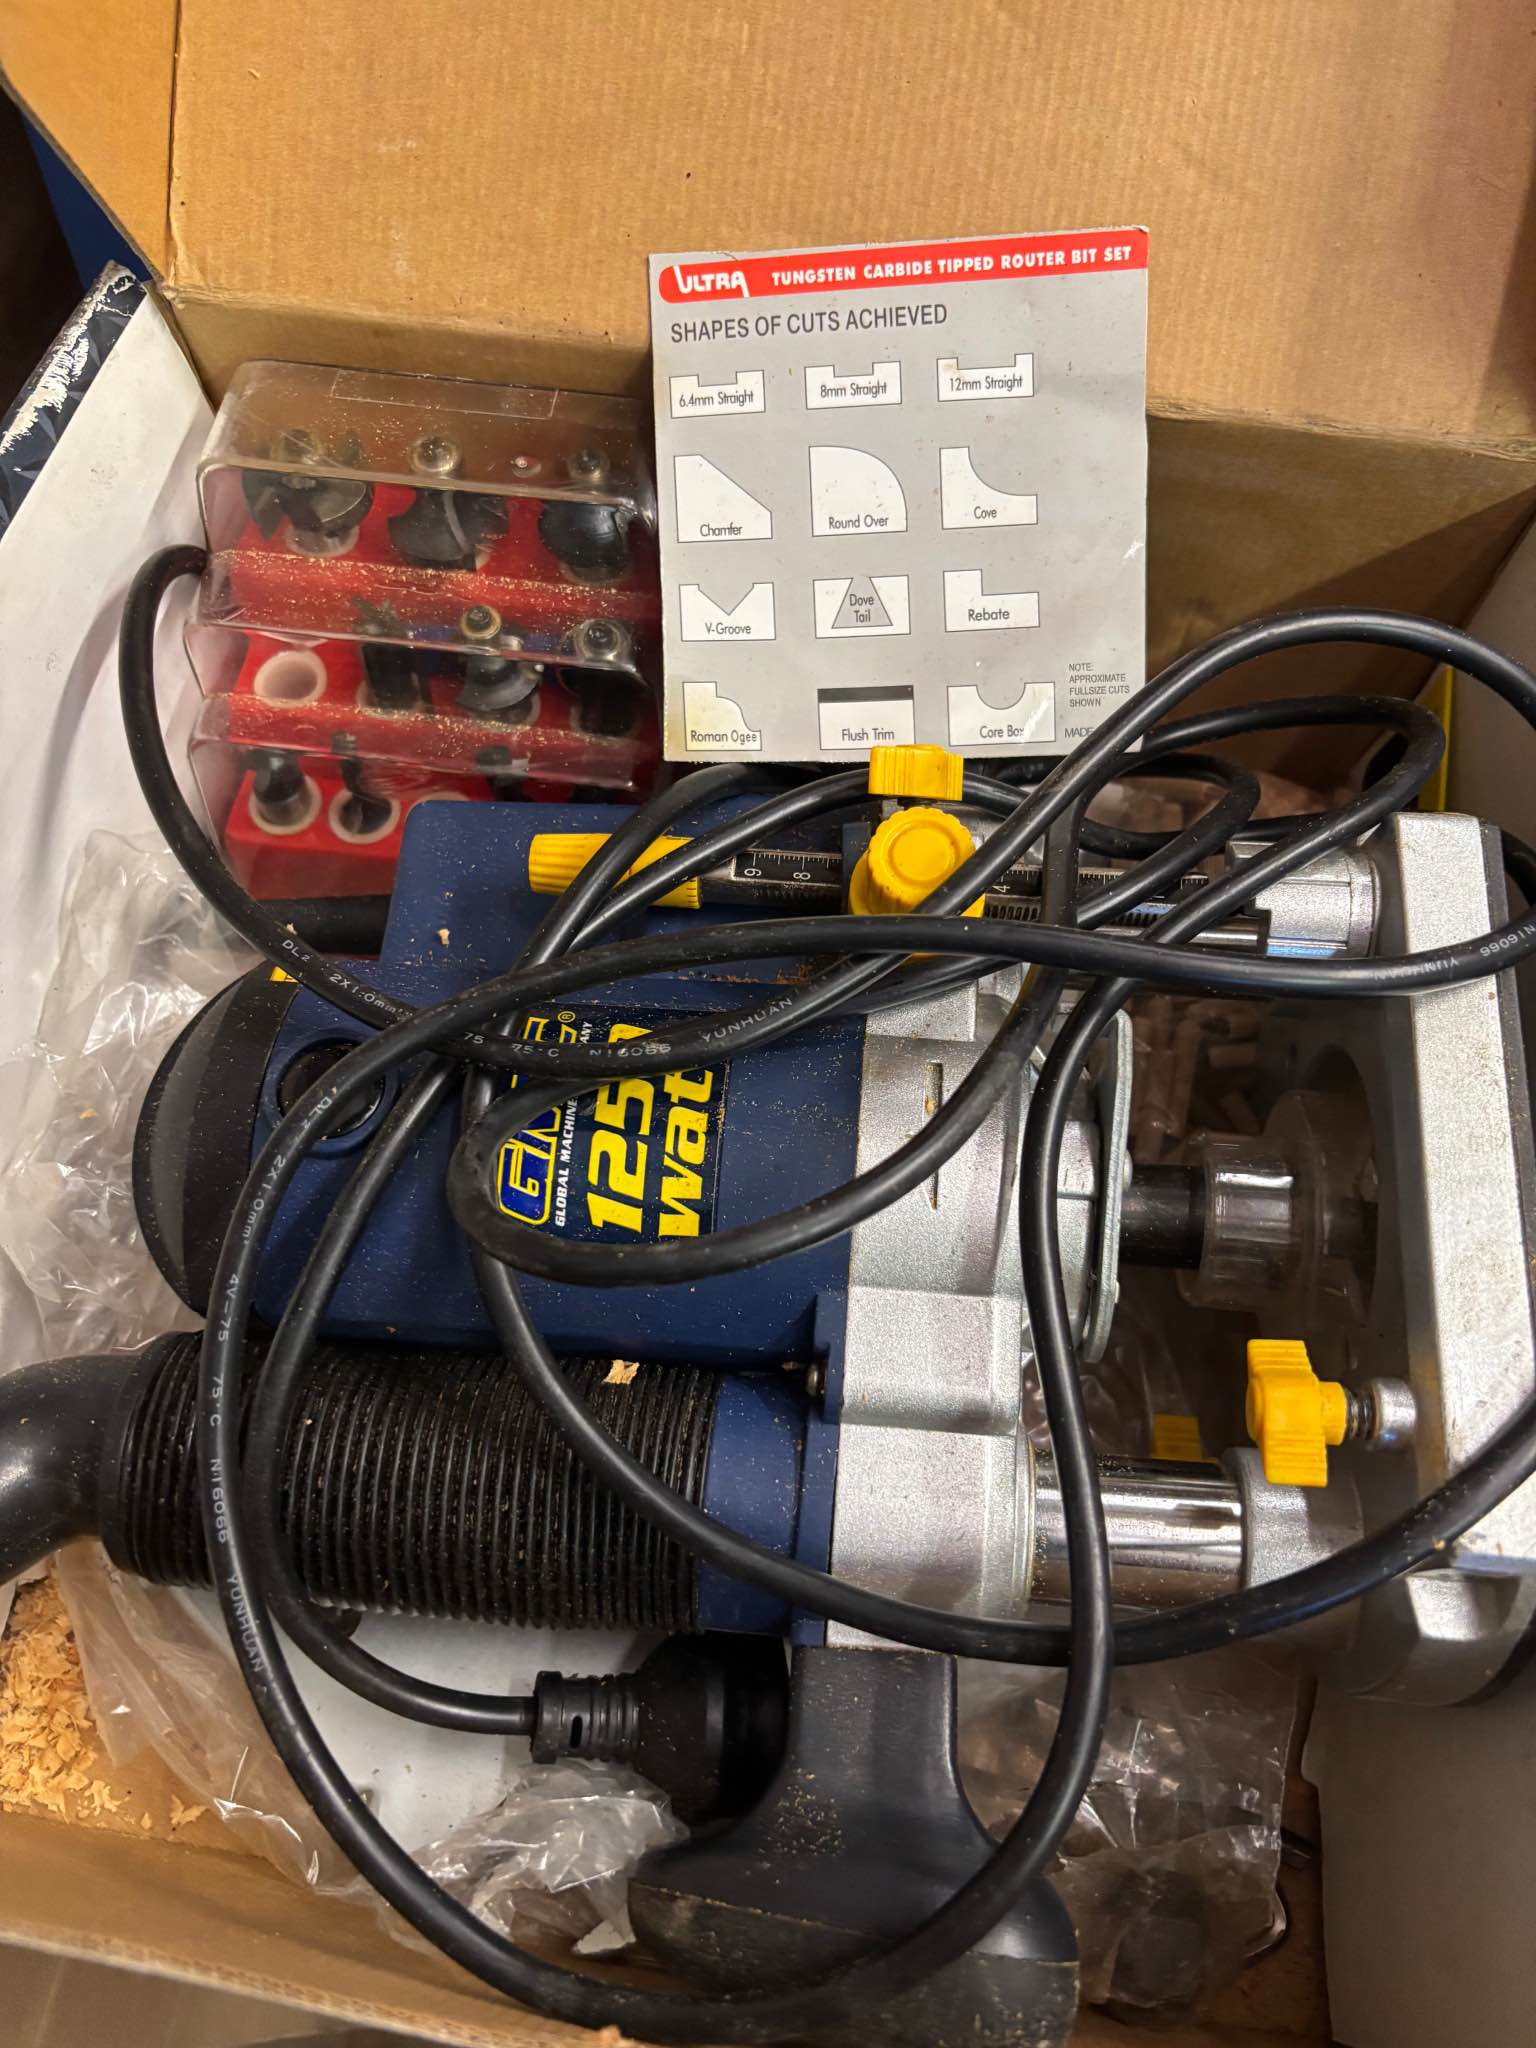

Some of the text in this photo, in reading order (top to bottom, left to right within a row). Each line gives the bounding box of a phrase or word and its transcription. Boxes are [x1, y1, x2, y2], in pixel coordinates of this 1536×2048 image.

[673, 246, 1132, 298] ULTRA TUNGSTEN CARBIDE TIPPED ROUTER BIT SET
[671, 303, 948, 343] SHAPES OF CUTS ACHIEVED
[820, 381, 887, 399] 8mm Straight
[949, 373, 1024, 393] 12mm Straight
[679, 390, 754, 408] 6.4mm Straight
[973, 506, 998, 520] Cove
[828, 515, 889, 530] Round Over
[699, 523, 743, 538] Chamfer
[849, 593, 875, 607] Dove
[853, 609, 872, 623] Tail
[967, 607, 1011, 623] Rebate
[705, 622, 752, 636] V-Groove
[1069, 673, 1127, 684] APPROXIMATE
[1069, 685, 1130, 697] FULLSIZE CUTS
[1069, 697, 1101, 708] SHOWN
[690, 731, 758, 745] Roman Ogee
[841, 727, 895, 742] Flush Trim
[979, 724, 1025, 739] Core Box
[702, 998, 793, 1043] YUNHUAN
[560, 1098, 578, 1163] MACHINE
[586, 1023, 654, 1233] 125
[657, 1066, 714, 1238] Wat
[554, 1166, 571, 1227] GLOBAL
[227, 1573, 266, 1673] YUNHUAN
